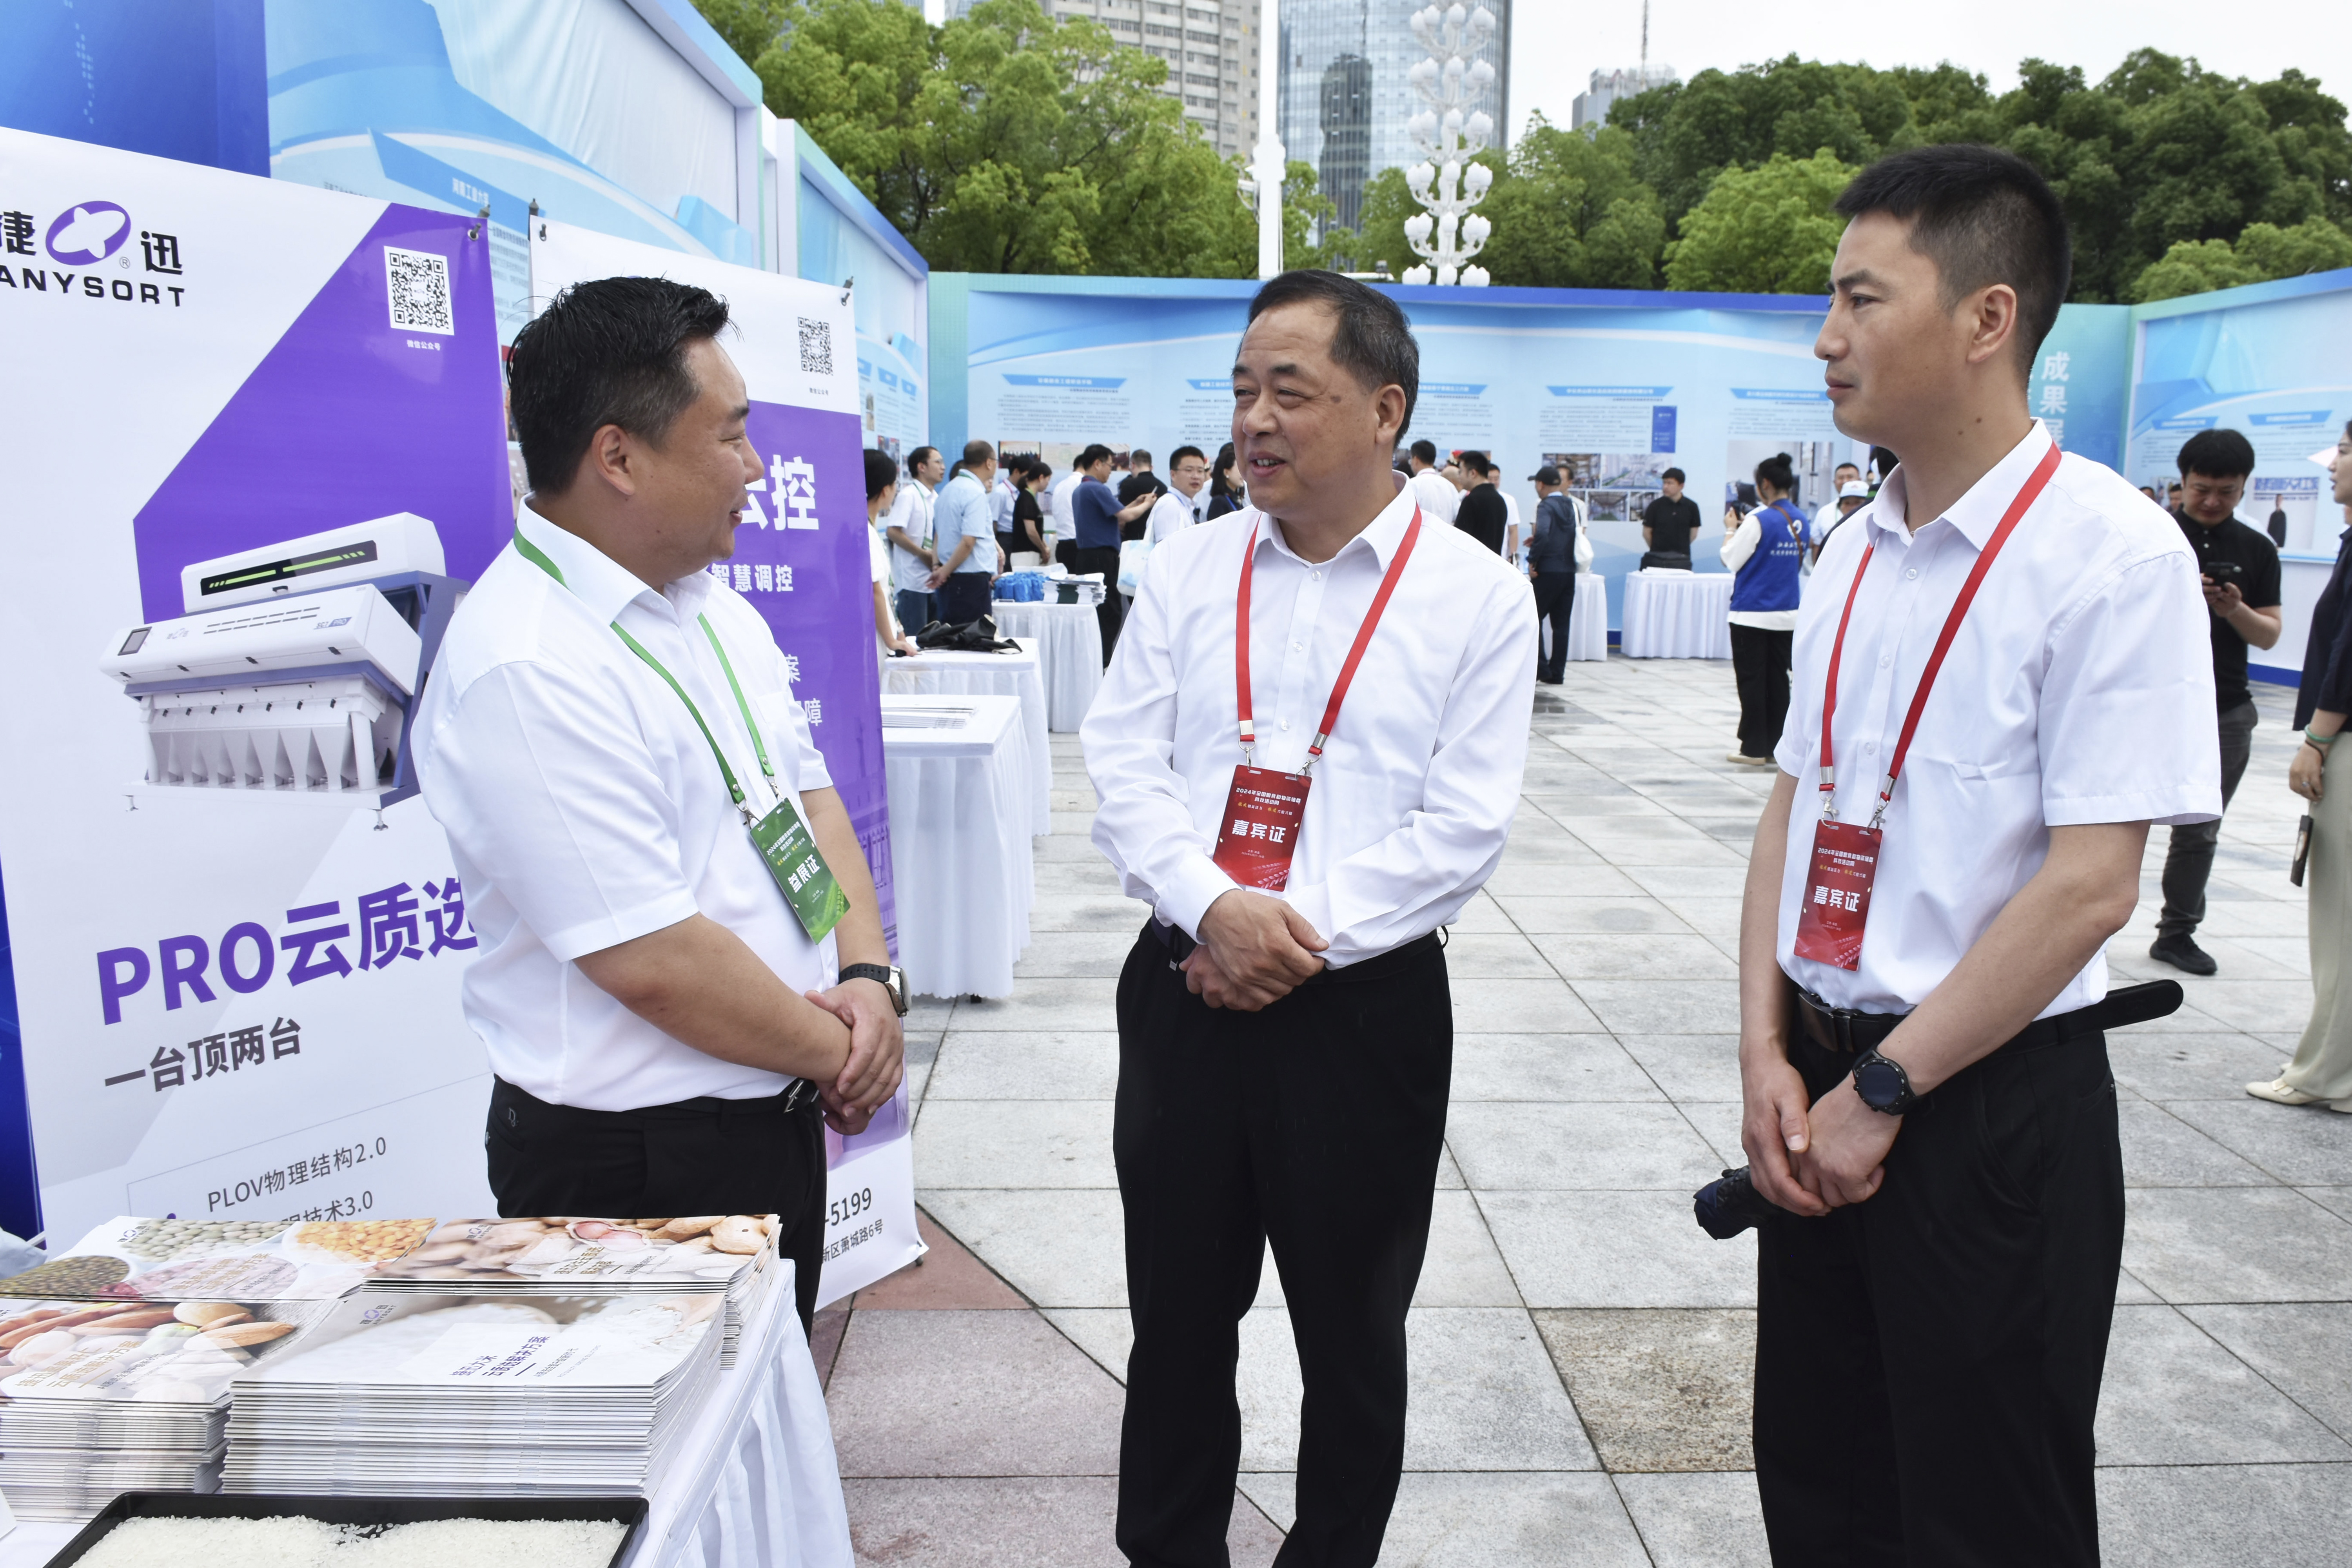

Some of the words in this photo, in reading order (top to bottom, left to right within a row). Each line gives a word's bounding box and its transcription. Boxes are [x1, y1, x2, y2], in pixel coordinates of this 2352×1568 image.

[0, 211, 37, 256] 捷
[140, 230, 183, 275] 迅
[0, 265, 185, 307] ANYSORT
[407, 339, 440, 351] 微信公众号
[711, 563, 793, 592] 智慧调控
[795, 698, 822, 726] 障
[1232, 820, 1286, 843] 嘉宾证
[788, 854, 820, 893] 参展证
[1814, 886, 1860, 912] 嘉宾证
[105, 1017, 301, 1093] 一台顶两台
[209, 1137, 386, 1212] PLOV物理结构2.0
[373, 1305, 396, 1325] ANYSORT
[46, 1340, 143, 1388] 云质选解决方案
[450, 1356, 497, 1376] 捷迅大米
[481, 1336, 550, 1376] 云质选解决方案
